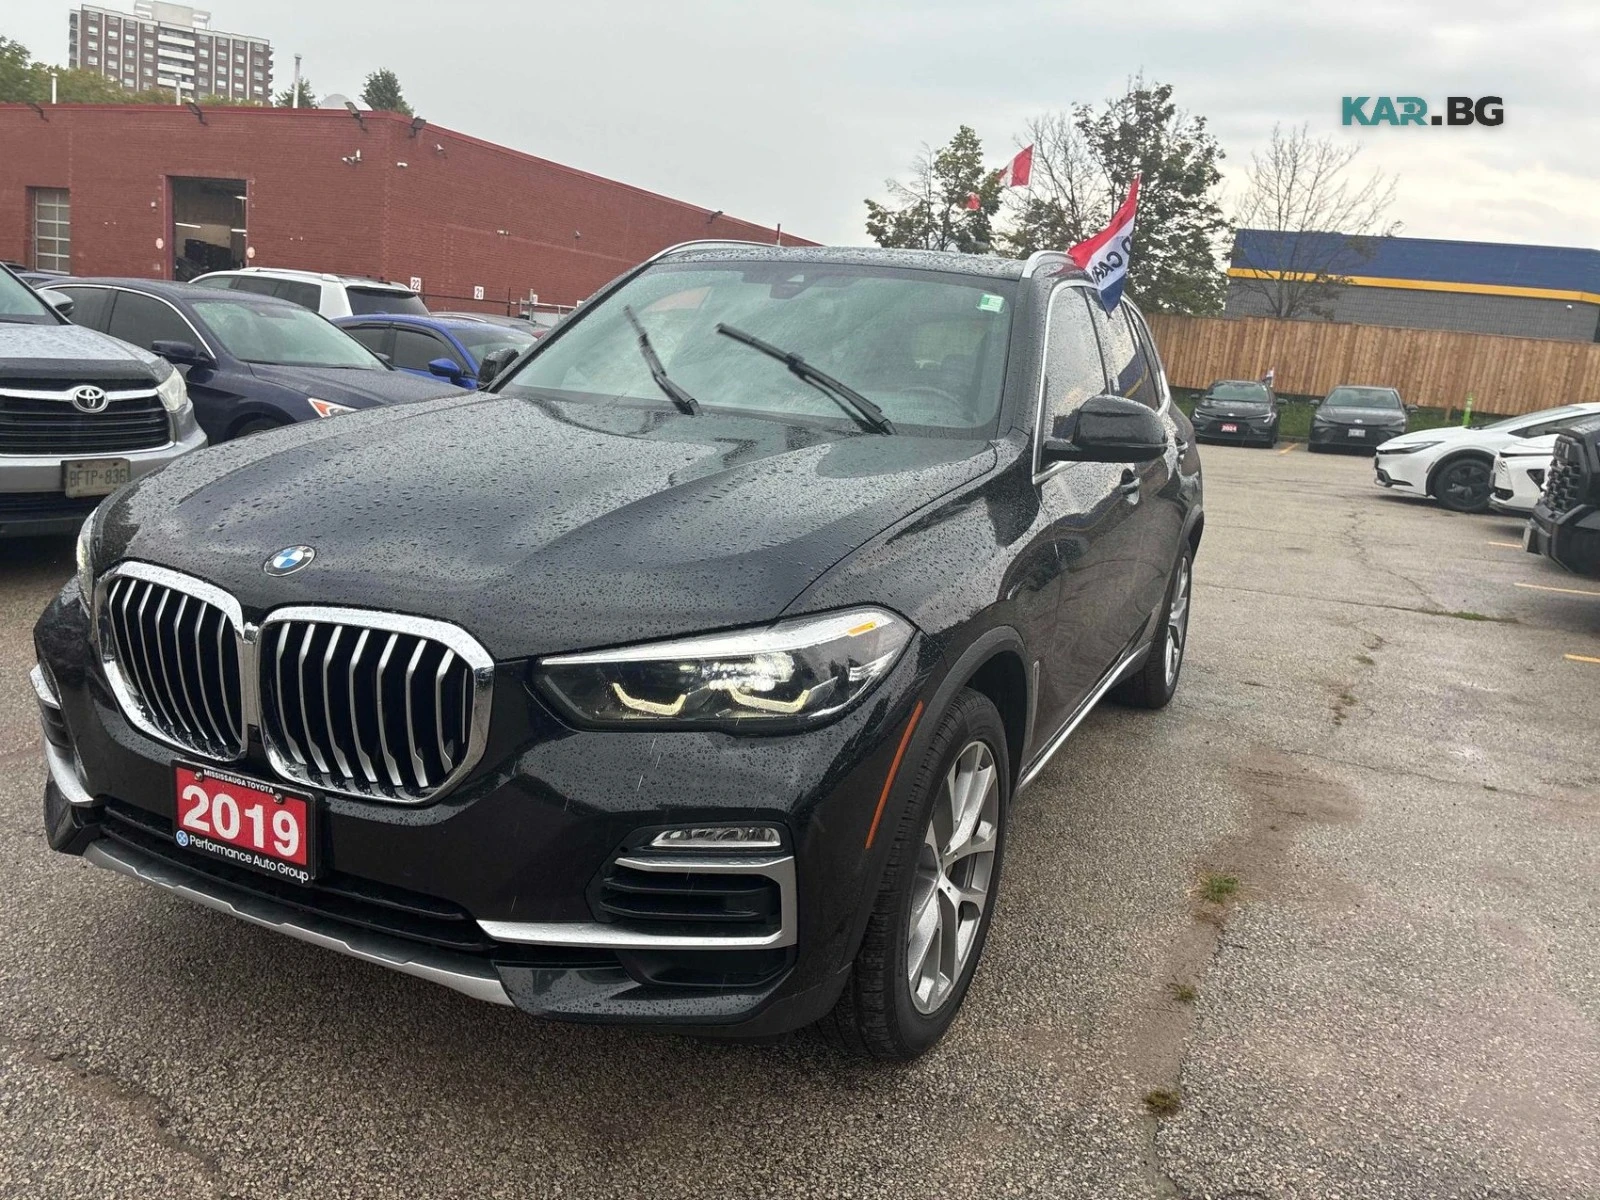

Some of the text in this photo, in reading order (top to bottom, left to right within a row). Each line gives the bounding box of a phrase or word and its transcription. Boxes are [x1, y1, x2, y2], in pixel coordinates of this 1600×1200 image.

[412, 280, 420, 291] 22
[475, 289, 483, 298] 21
[203, 769, 274, 794] MISSISSAUGA TOYOTA
[182, 785, 299, 857] 2019
[189, 835, 309, 884] Performance Auto Group
